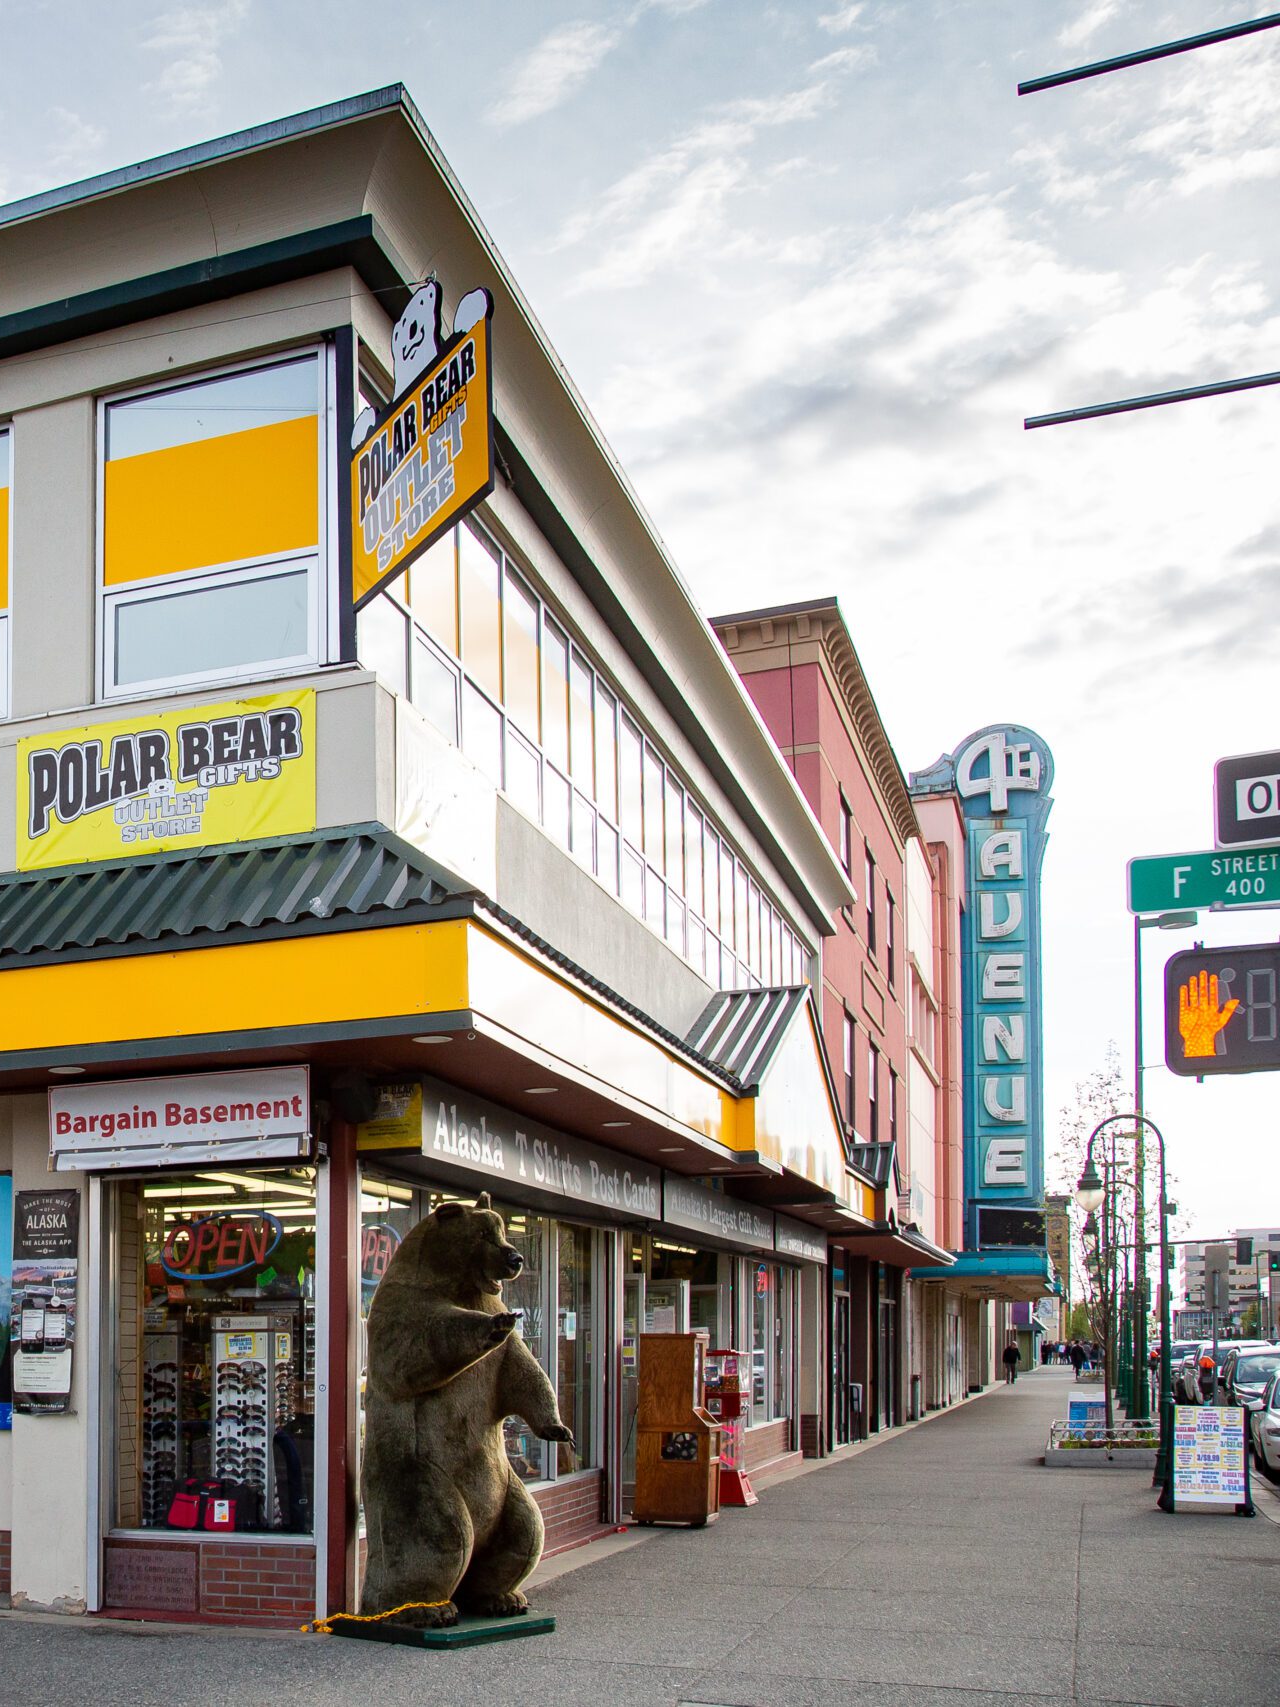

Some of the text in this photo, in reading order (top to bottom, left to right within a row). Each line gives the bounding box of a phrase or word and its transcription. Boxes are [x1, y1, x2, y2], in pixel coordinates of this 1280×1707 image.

[359, 338, 475, 526] POLAR BEAR
[429, 385, 467, 435] GIFTS
[363, 404, 467, 554] OUTLET
[377, 463, 456, 573] STORE
[28, 707, 302, 839] POLAR BEAR
[198, 756, 280, 788] GIFTS
[114, 788, 208, 824] OUTLET
[1247, 779, 1280, 815] O
[121, 816, 201, 842] STORE
[1173, 854, 1279, 898] F STREET
[1225, 877, 1266, 897] 400
[979, 831, 1024, 1185] AVENUE
[55, 1095, 302, 1138] Bargain Basement
[433, 1101, 505, 1171] Alaska
[515, 1130, 528, 1177] T
[533, 1139, 582, 1194] Shirts
[589, 1160, 620, 1204] Post
[623, 1171, 656, 1212] Cards
[23, 1200, 40, 1210] MAKE
[55, 1198, 72, 1208] MOST
[26, 1213, 67, 1229] ALASKA
[671, 1188, 771, 1239] Alaska's Largest Gift Store
[164, 1222, 269, 1269] OPEN
[362, 1228, 399, 1275] PEN
